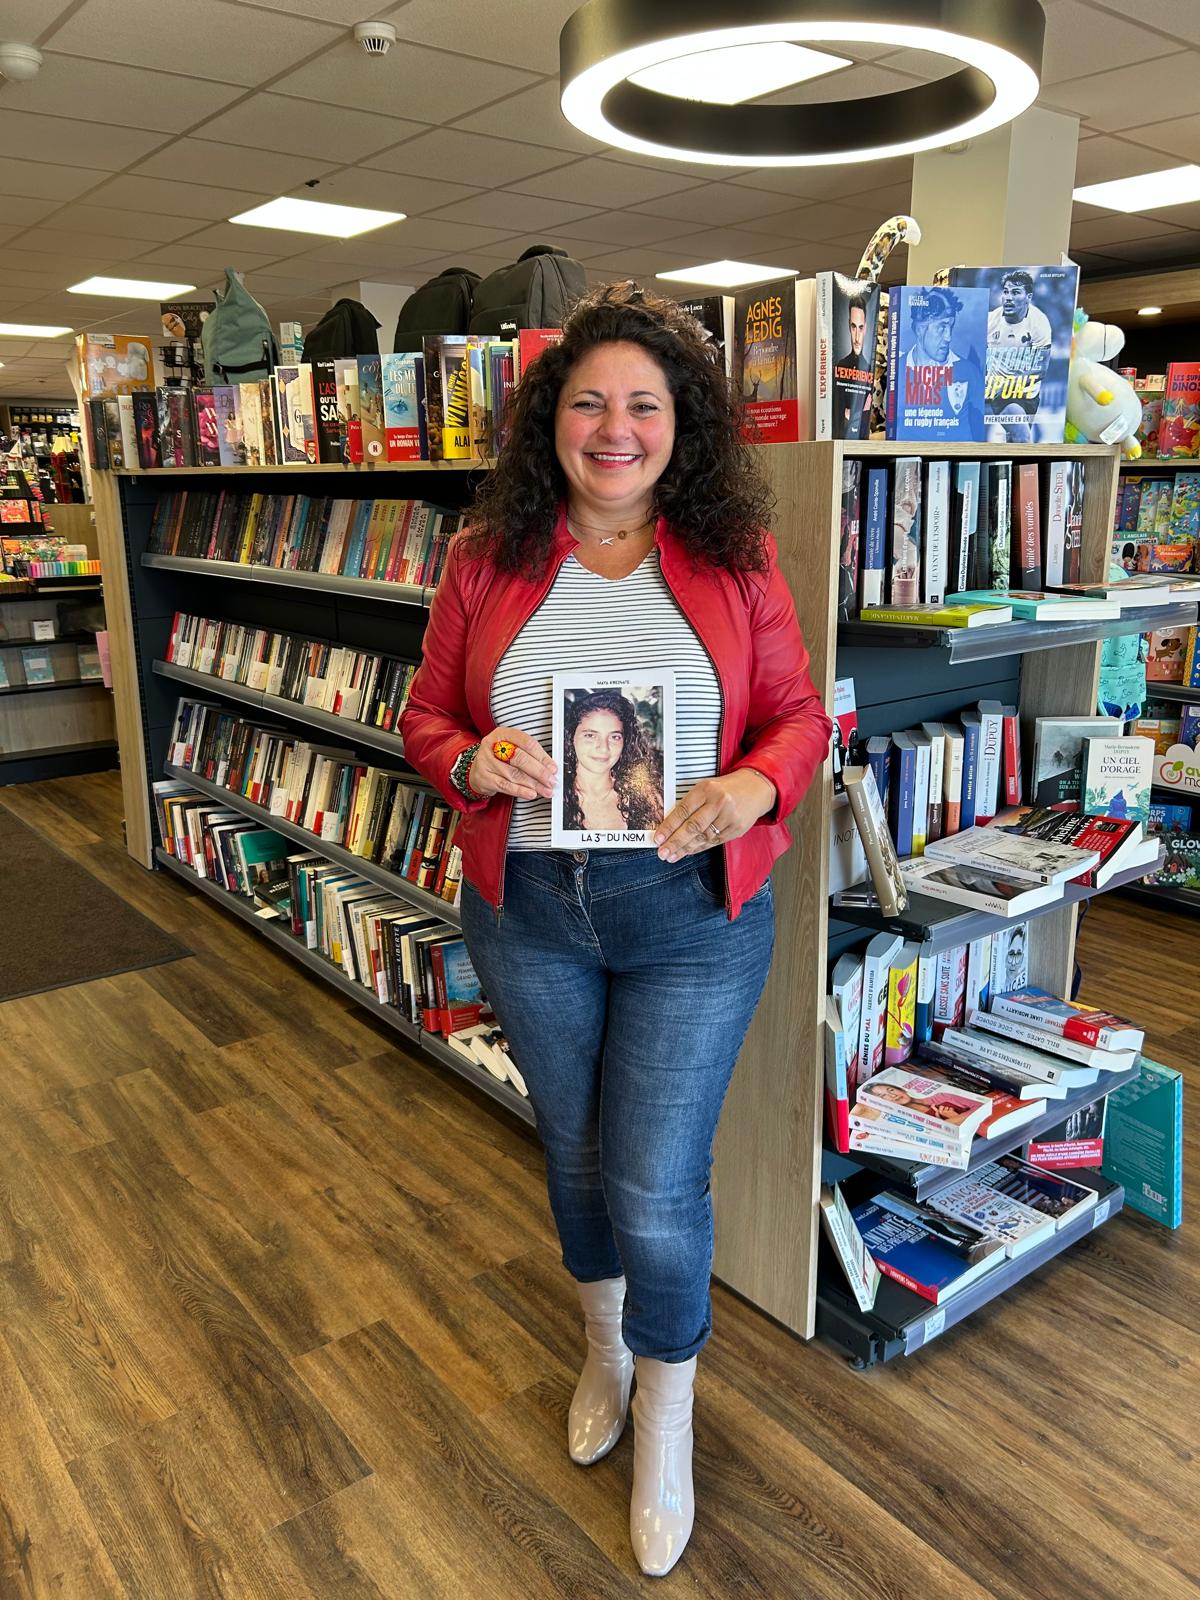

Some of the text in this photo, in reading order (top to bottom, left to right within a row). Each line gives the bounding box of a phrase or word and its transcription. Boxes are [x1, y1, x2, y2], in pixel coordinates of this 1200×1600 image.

[746, 296, 782, 323] AGNÈS
[744, 320, 783, 344] LEDIG
[985, 347, 1044, 371] NTOINE
[819, 338, 827, 399] L'EXPÉRIENCE
[905, 366, 953, 386] LUCIEN
[984, 375, 1040, 400] PONT
[904, 385, 942, 405] MIAS
[904, 408, 944, 418] une légende
[904, 418, 959, 429] du rugby français
[1054, 470, 1063, 494] STEEL
[1024, 501, 1035, 574] Vanité des vanités
[931, 554, 939, 573] VENT
[984, 720, 998, 756] DUPUY
[1119, 757, 1140, 765] CIEL
[1100, 765, 1142, 774] D'ORAGE
[1151, 809, 1166, 817] RPS
[582, 833, 592, 841] LA
[607, 833, 620, 841] DU
[622, 833, 645, 841] NOM
[941, 966, 950, 980] SUITE
[940, 981, 949, 994] SANS
[1006, 1006, 1043, 1023] LIANE MORIARTY
[976, 1016, 997, 1028] SOURCE
[999, 1023, 1013, 1033] CODE
[864, 1033, 870, 1042] DU
[1027, 1033, 1045, 1043] GATES
[1046, 1039, 1060, 1048] BILL
[862, 1044, 870, 1066] GÉNIES
[998, 1052, 1023, 1067] FRONTIÈRES
[1022, 1062, 1032, 1070] LES
